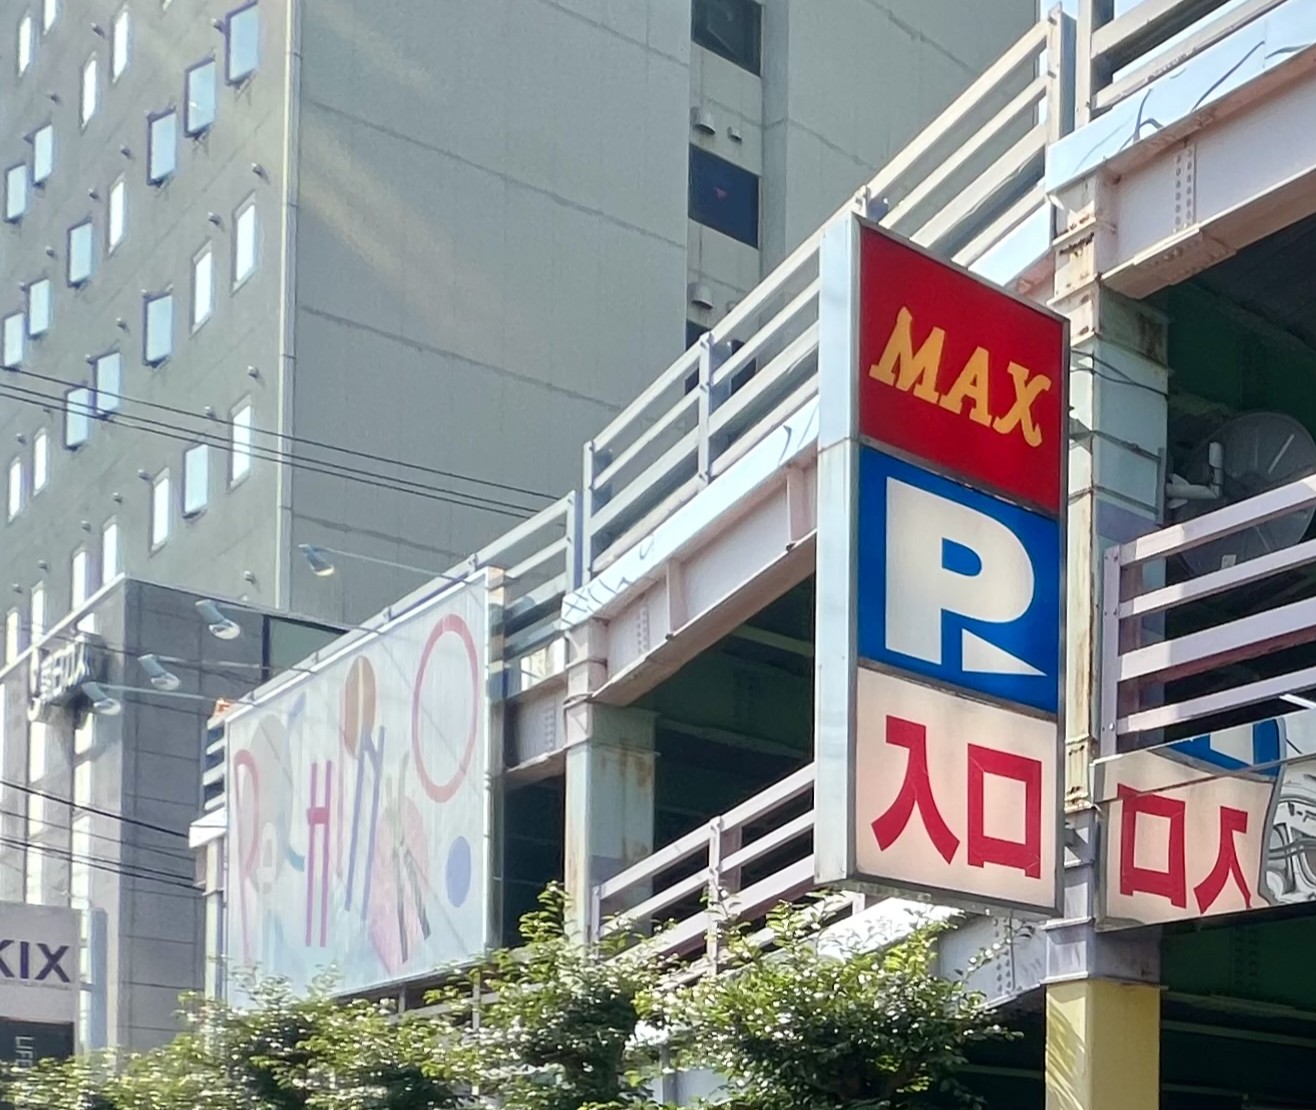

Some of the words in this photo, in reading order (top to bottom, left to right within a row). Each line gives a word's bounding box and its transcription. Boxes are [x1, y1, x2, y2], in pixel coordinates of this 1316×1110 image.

[869, 306, 1052, 448] MAX
[884, 476, 1036, 667] P
[870, 715, 1042, 879] 入口
